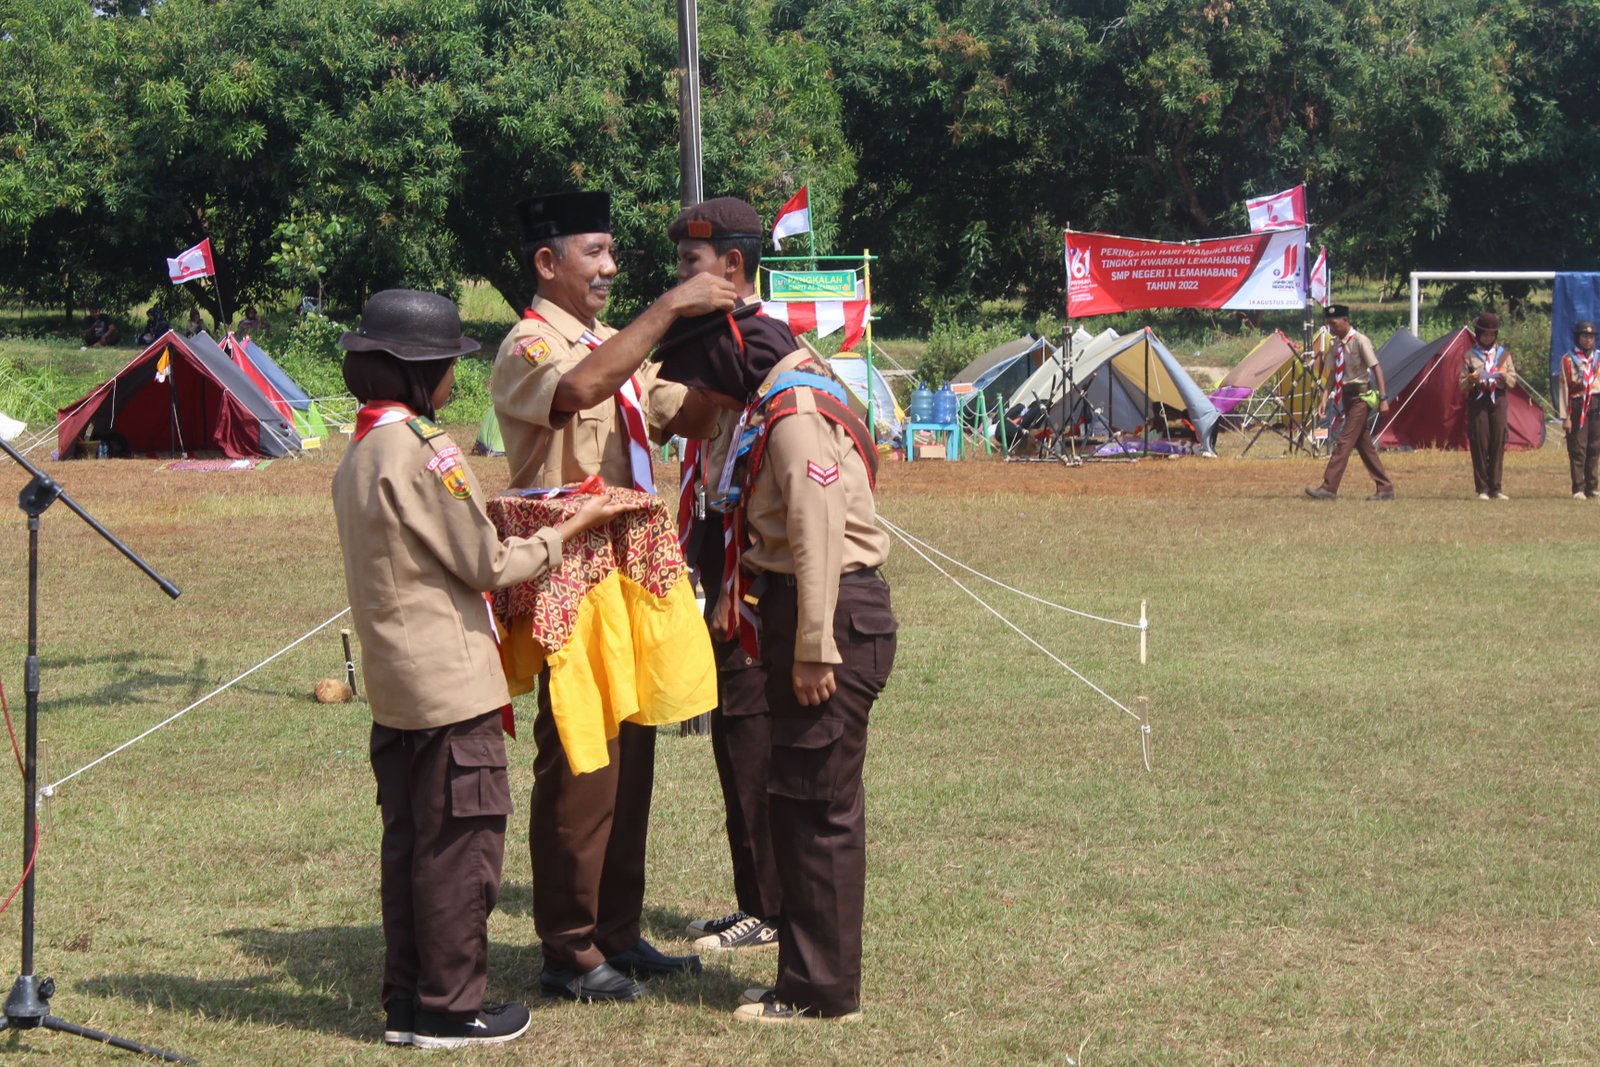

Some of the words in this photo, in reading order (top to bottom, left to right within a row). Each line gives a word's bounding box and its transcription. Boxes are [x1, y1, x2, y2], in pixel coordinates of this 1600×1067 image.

[1100, 247, 1156, 258] PERINGATAN
[1182, 247, 1226, 256] PRAMUKA
[1229, 244, 1254, 253] KE-61
[1071, 245, 1091, 279] 61
[1101, 259, 1138, 269] TINGKAT
[1140, 257, 1185, 266] KWARRAN
[1187, 255, 1250, 265] LEMAHABANG
[788, 275, 843, 284] PANGKALAN
[1111, 270, 1130, 281] SMP
[1132, 269, 1165, 279] NEGERI
[1167, 268, 1172, 278] 1
[1174, 267, 1238, 278] LEMAHABANG
[1146, 281, 1176, 291] TAHUN
[1178, 280, 1199, 290] 2022
